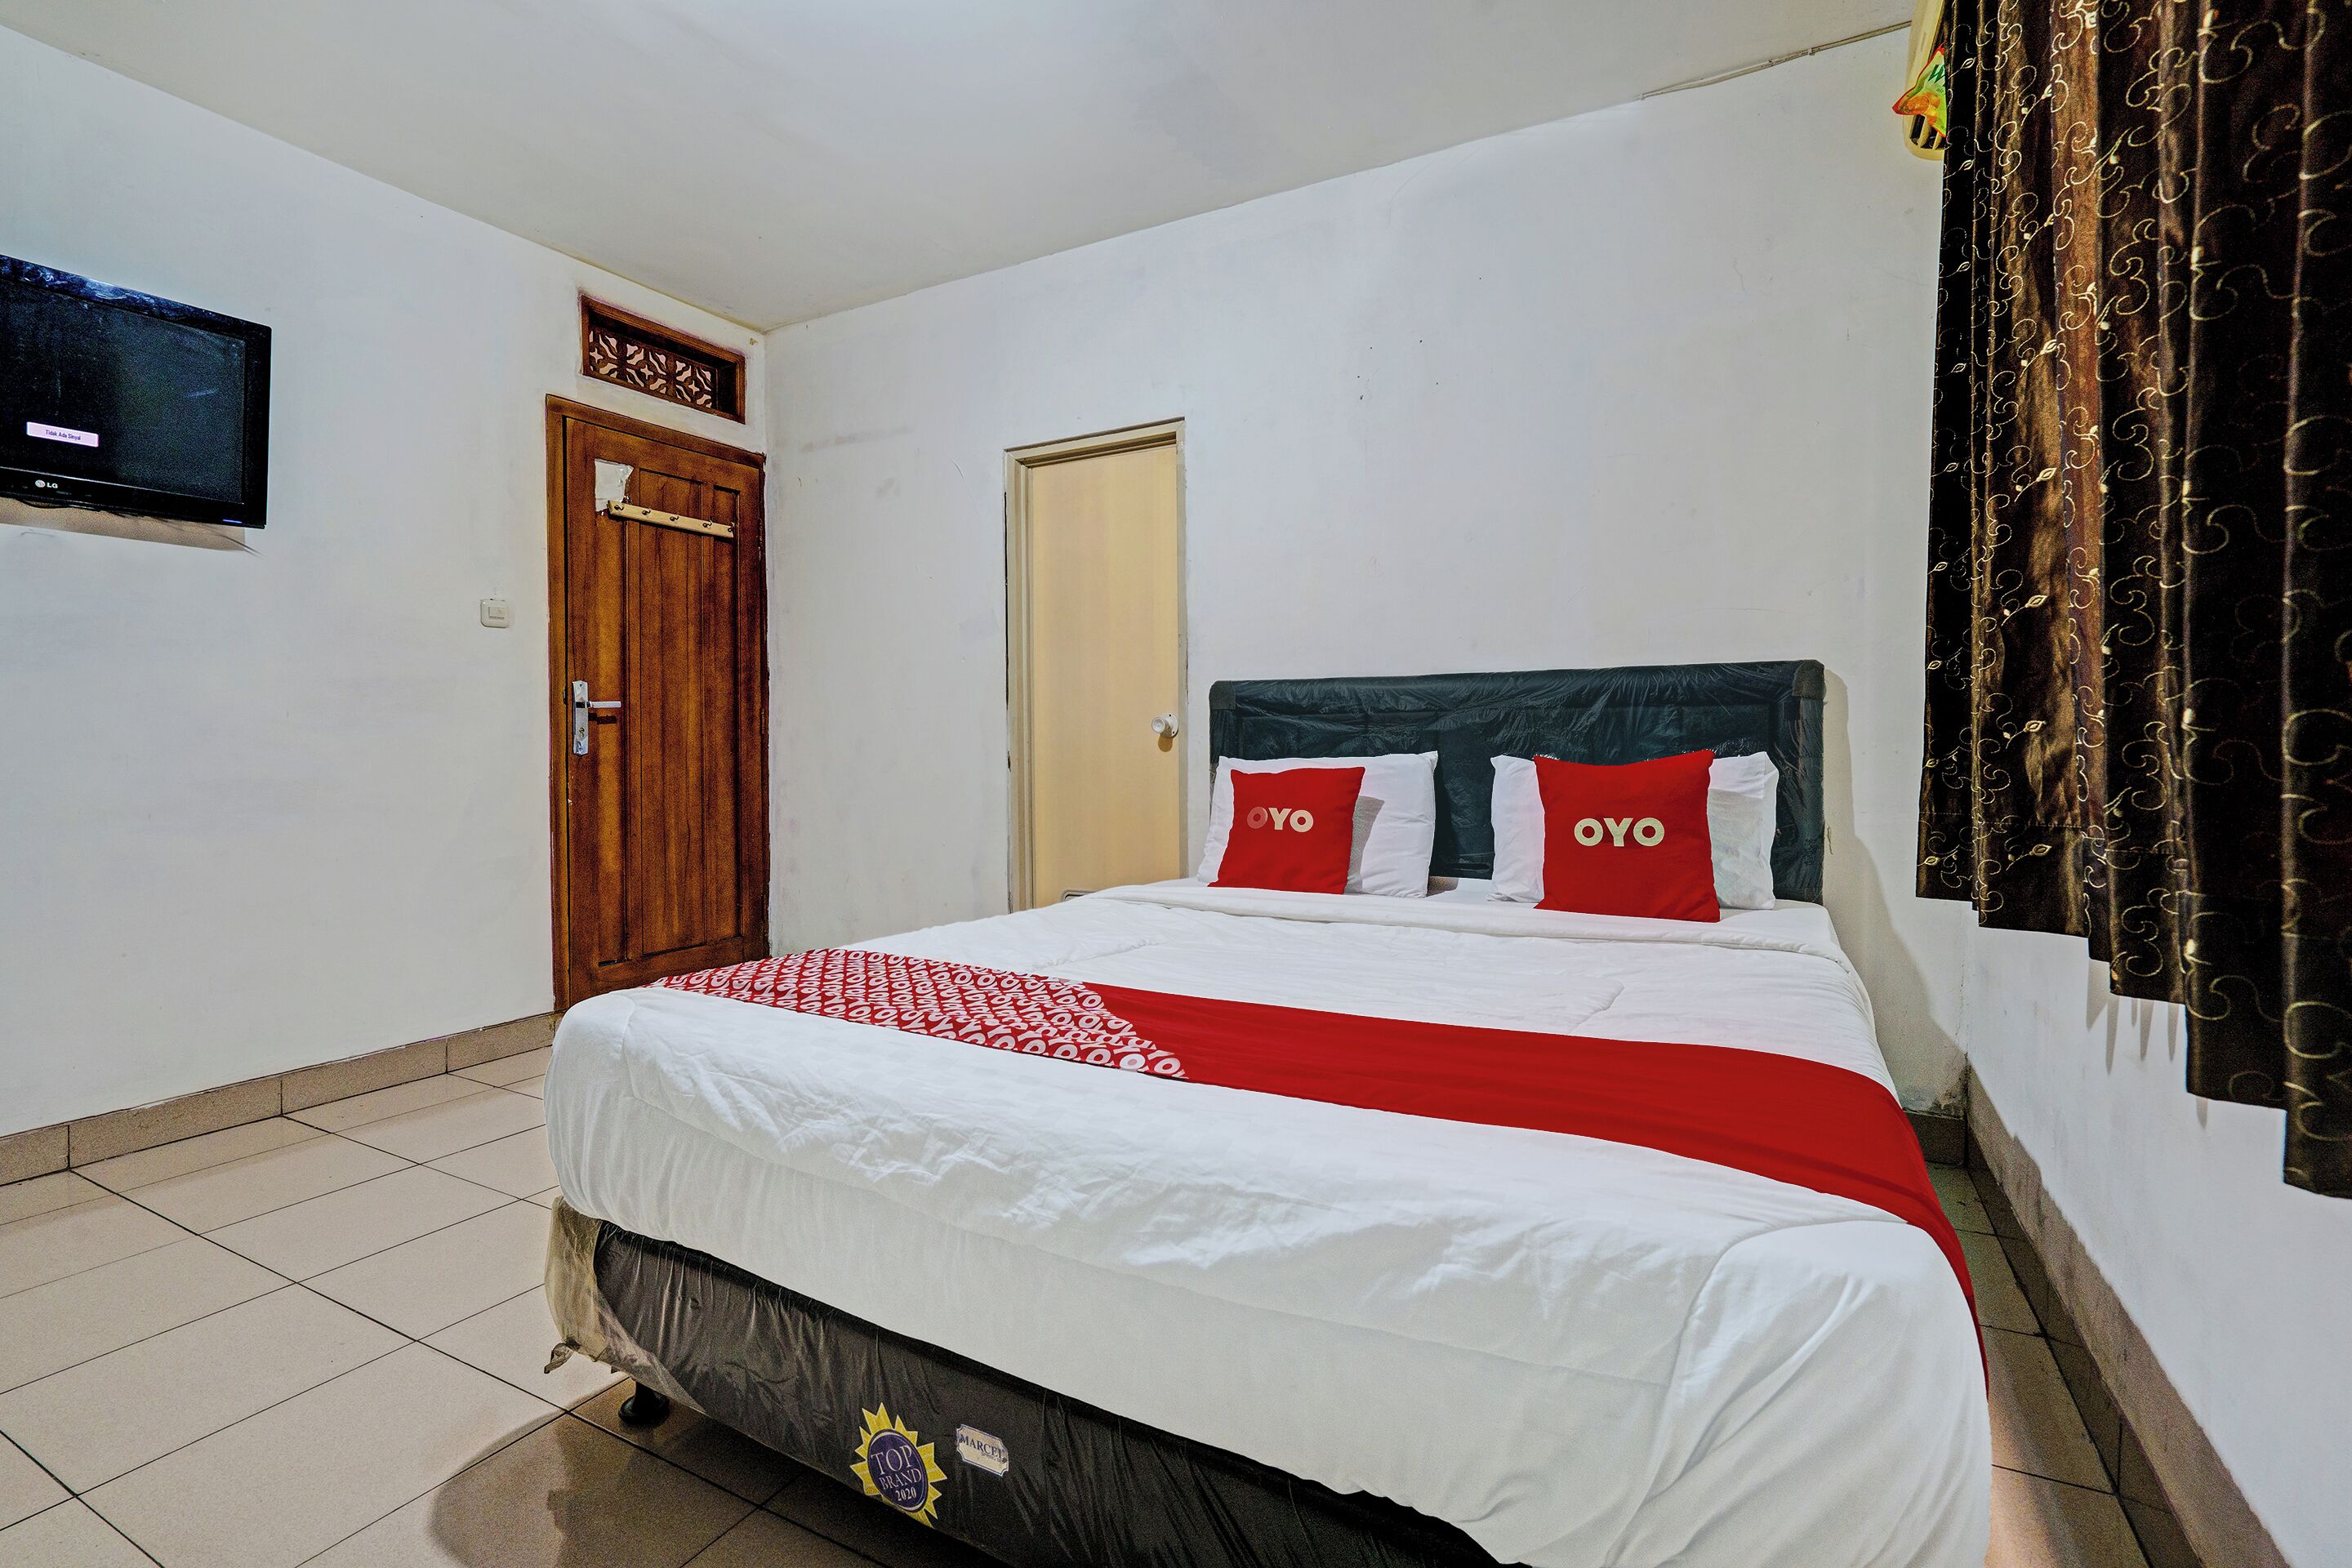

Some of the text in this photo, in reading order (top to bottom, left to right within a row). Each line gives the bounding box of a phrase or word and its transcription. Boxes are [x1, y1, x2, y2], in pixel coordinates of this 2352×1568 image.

[1246, 806, 1314, 833] OYO
[1574, 817, 1665, 847] OYO
[871, 1445, 913, 1476] TOP
[879, 1468, 922, 1490] BRAND
[895, 1486, 917, 1502] 2020
